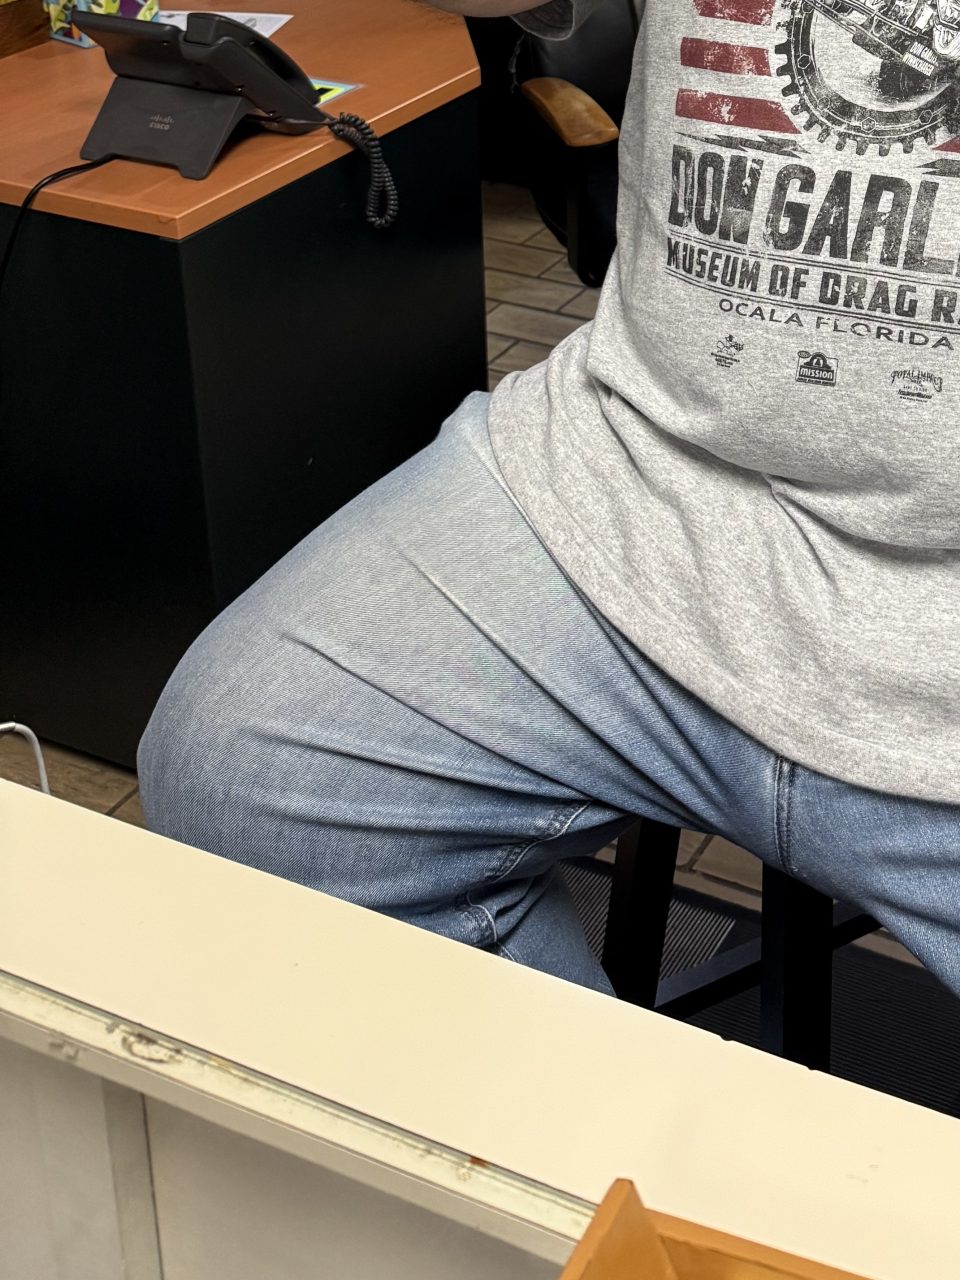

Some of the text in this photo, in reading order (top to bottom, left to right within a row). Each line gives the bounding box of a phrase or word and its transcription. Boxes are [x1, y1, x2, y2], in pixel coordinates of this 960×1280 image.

[668, 144, 764, 245] DON
[667, 237, 761, 293] MUSEUM
[768, 264, 810, 300] OF
[818, 271, 918, 318] DRAG
[719, 298, 955, 351] OCALA FLORIDA
